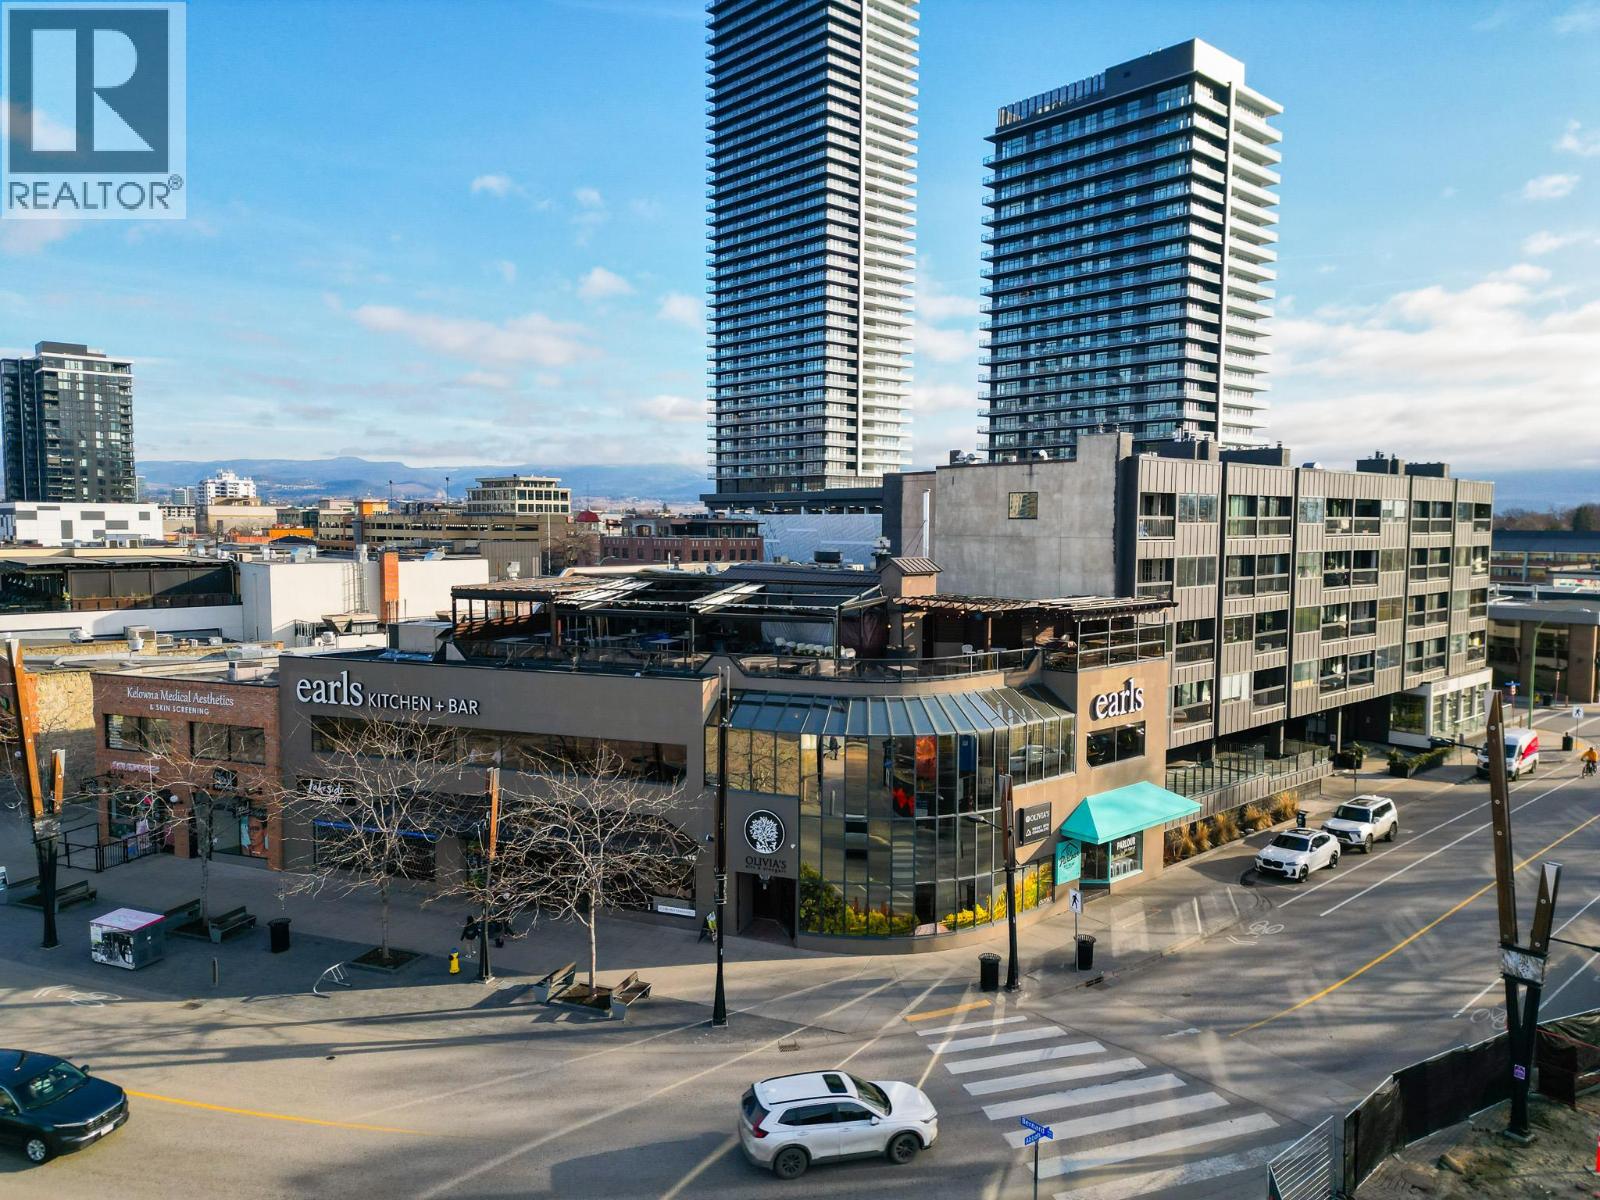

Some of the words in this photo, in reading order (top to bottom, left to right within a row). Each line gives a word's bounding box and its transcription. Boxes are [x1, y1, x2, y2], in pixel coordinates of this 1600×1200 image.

[127, 687, 159, 700] Kelowna
[160, 689, 191, 704] Medical
[193, 692, 234, 707] Aesthetics
[296, 671, 363, 706] earls
[368, 692, 431, 711] KITCHEN
[449, 698, 478, 715] BAR
[1094, 677, 1145, 720] earls
[155, 704, 171, 712] SKIN
[172, 706, 210, 715] SCREENING
[745, 855, 787, 870] OLIVIA'S
